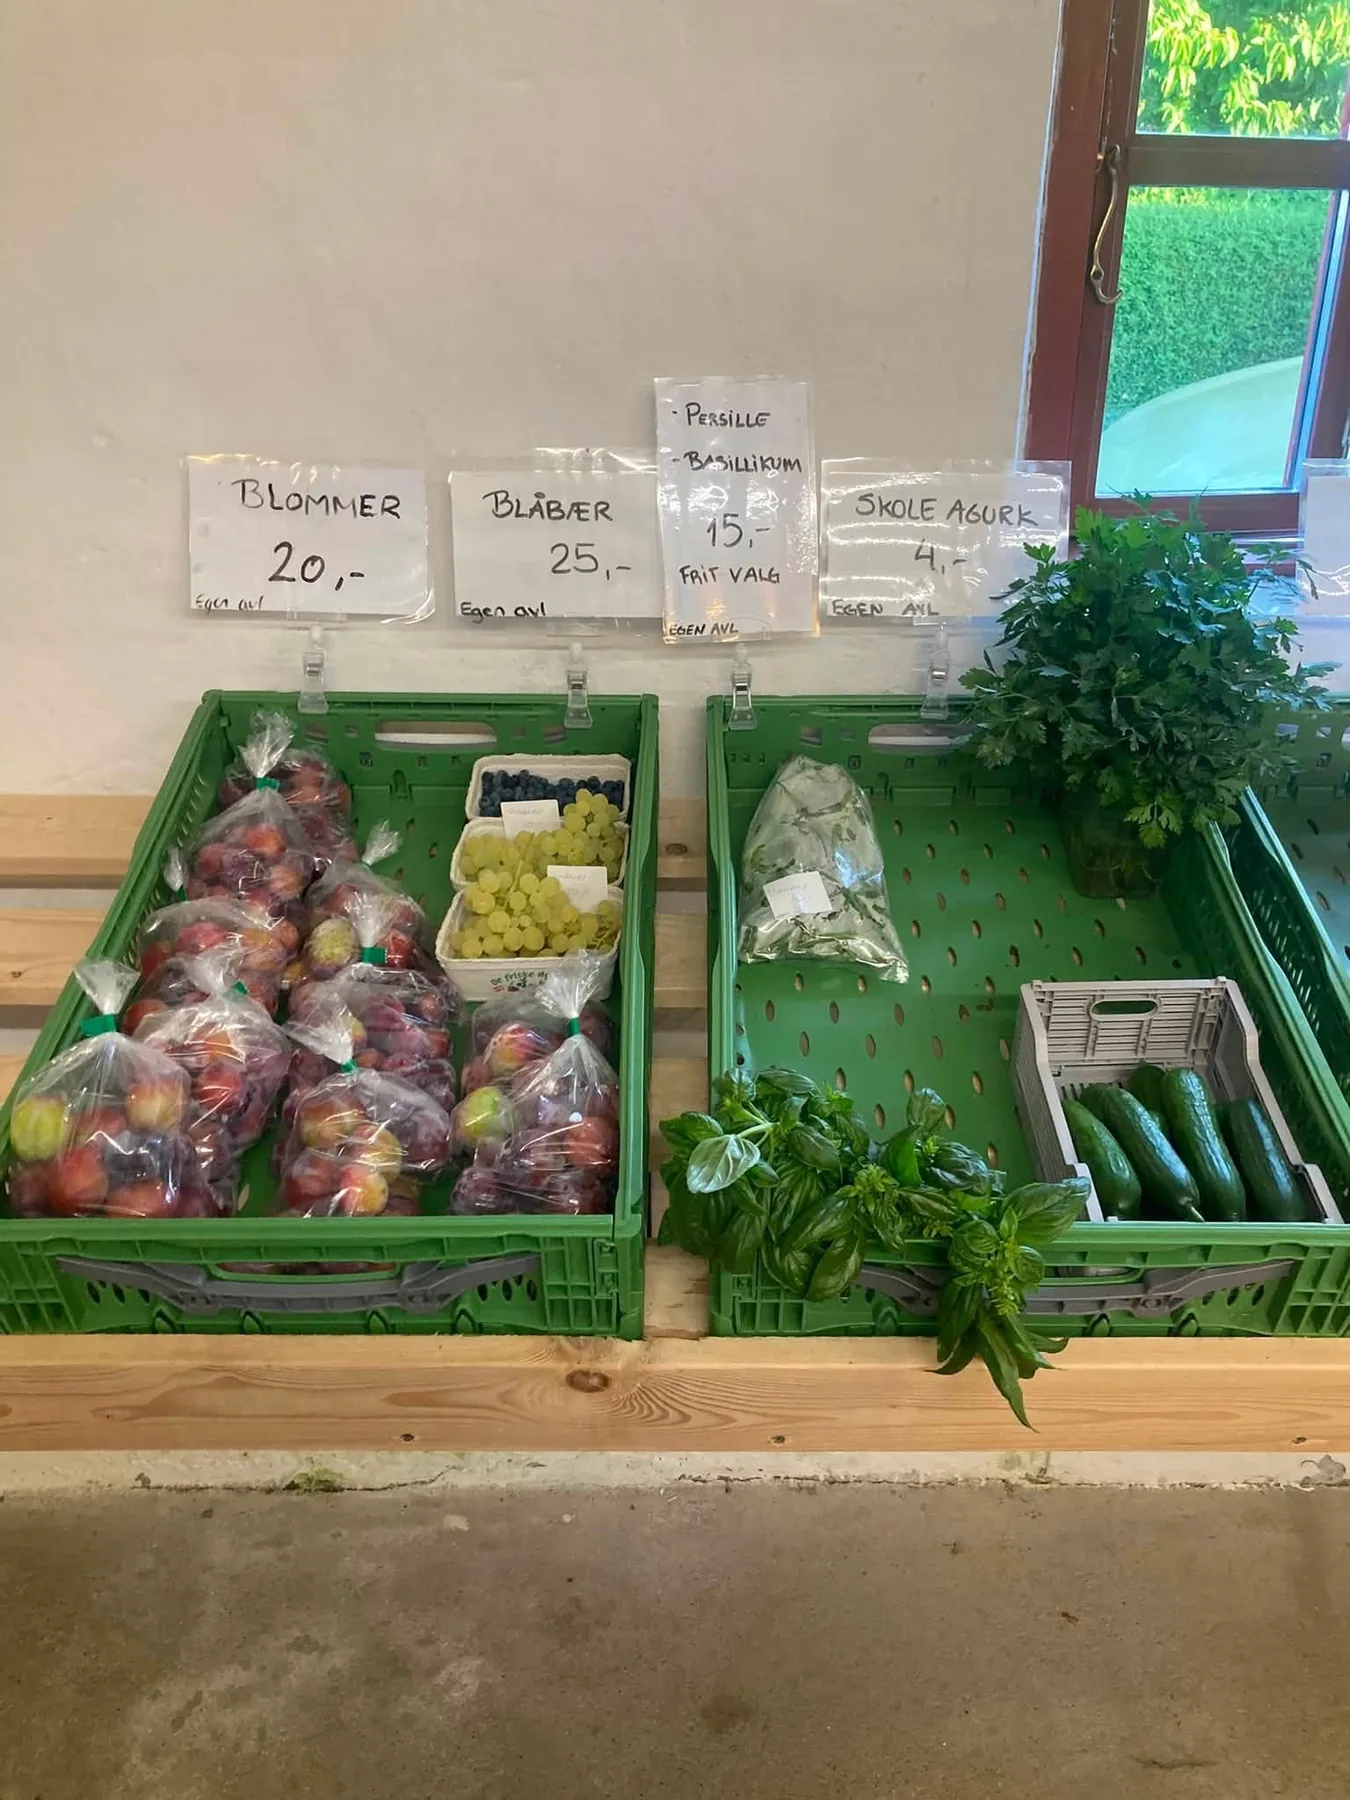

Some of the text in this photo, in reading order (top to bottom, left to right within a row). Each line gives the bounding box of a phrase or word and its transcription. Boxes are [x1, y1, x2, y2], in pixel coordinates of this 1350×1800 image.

[231, 478, 401, 519] BLOMMER
[482, 489, 614, 522] BLÅBÆR
[855, 492, 1039, 528] SKOLE AGURK
[705, 512, 771, 548] 15,-
[267, 540, 365, 591] 20,-
[550, 542, 632, 581] 25,-
[729, 566, 780, 584] VALG
[460, 601, 547, 624] Egen avl
[832, 599, 884, 617] EGEN
[669, 622, 739, 636] EGEN AVL
